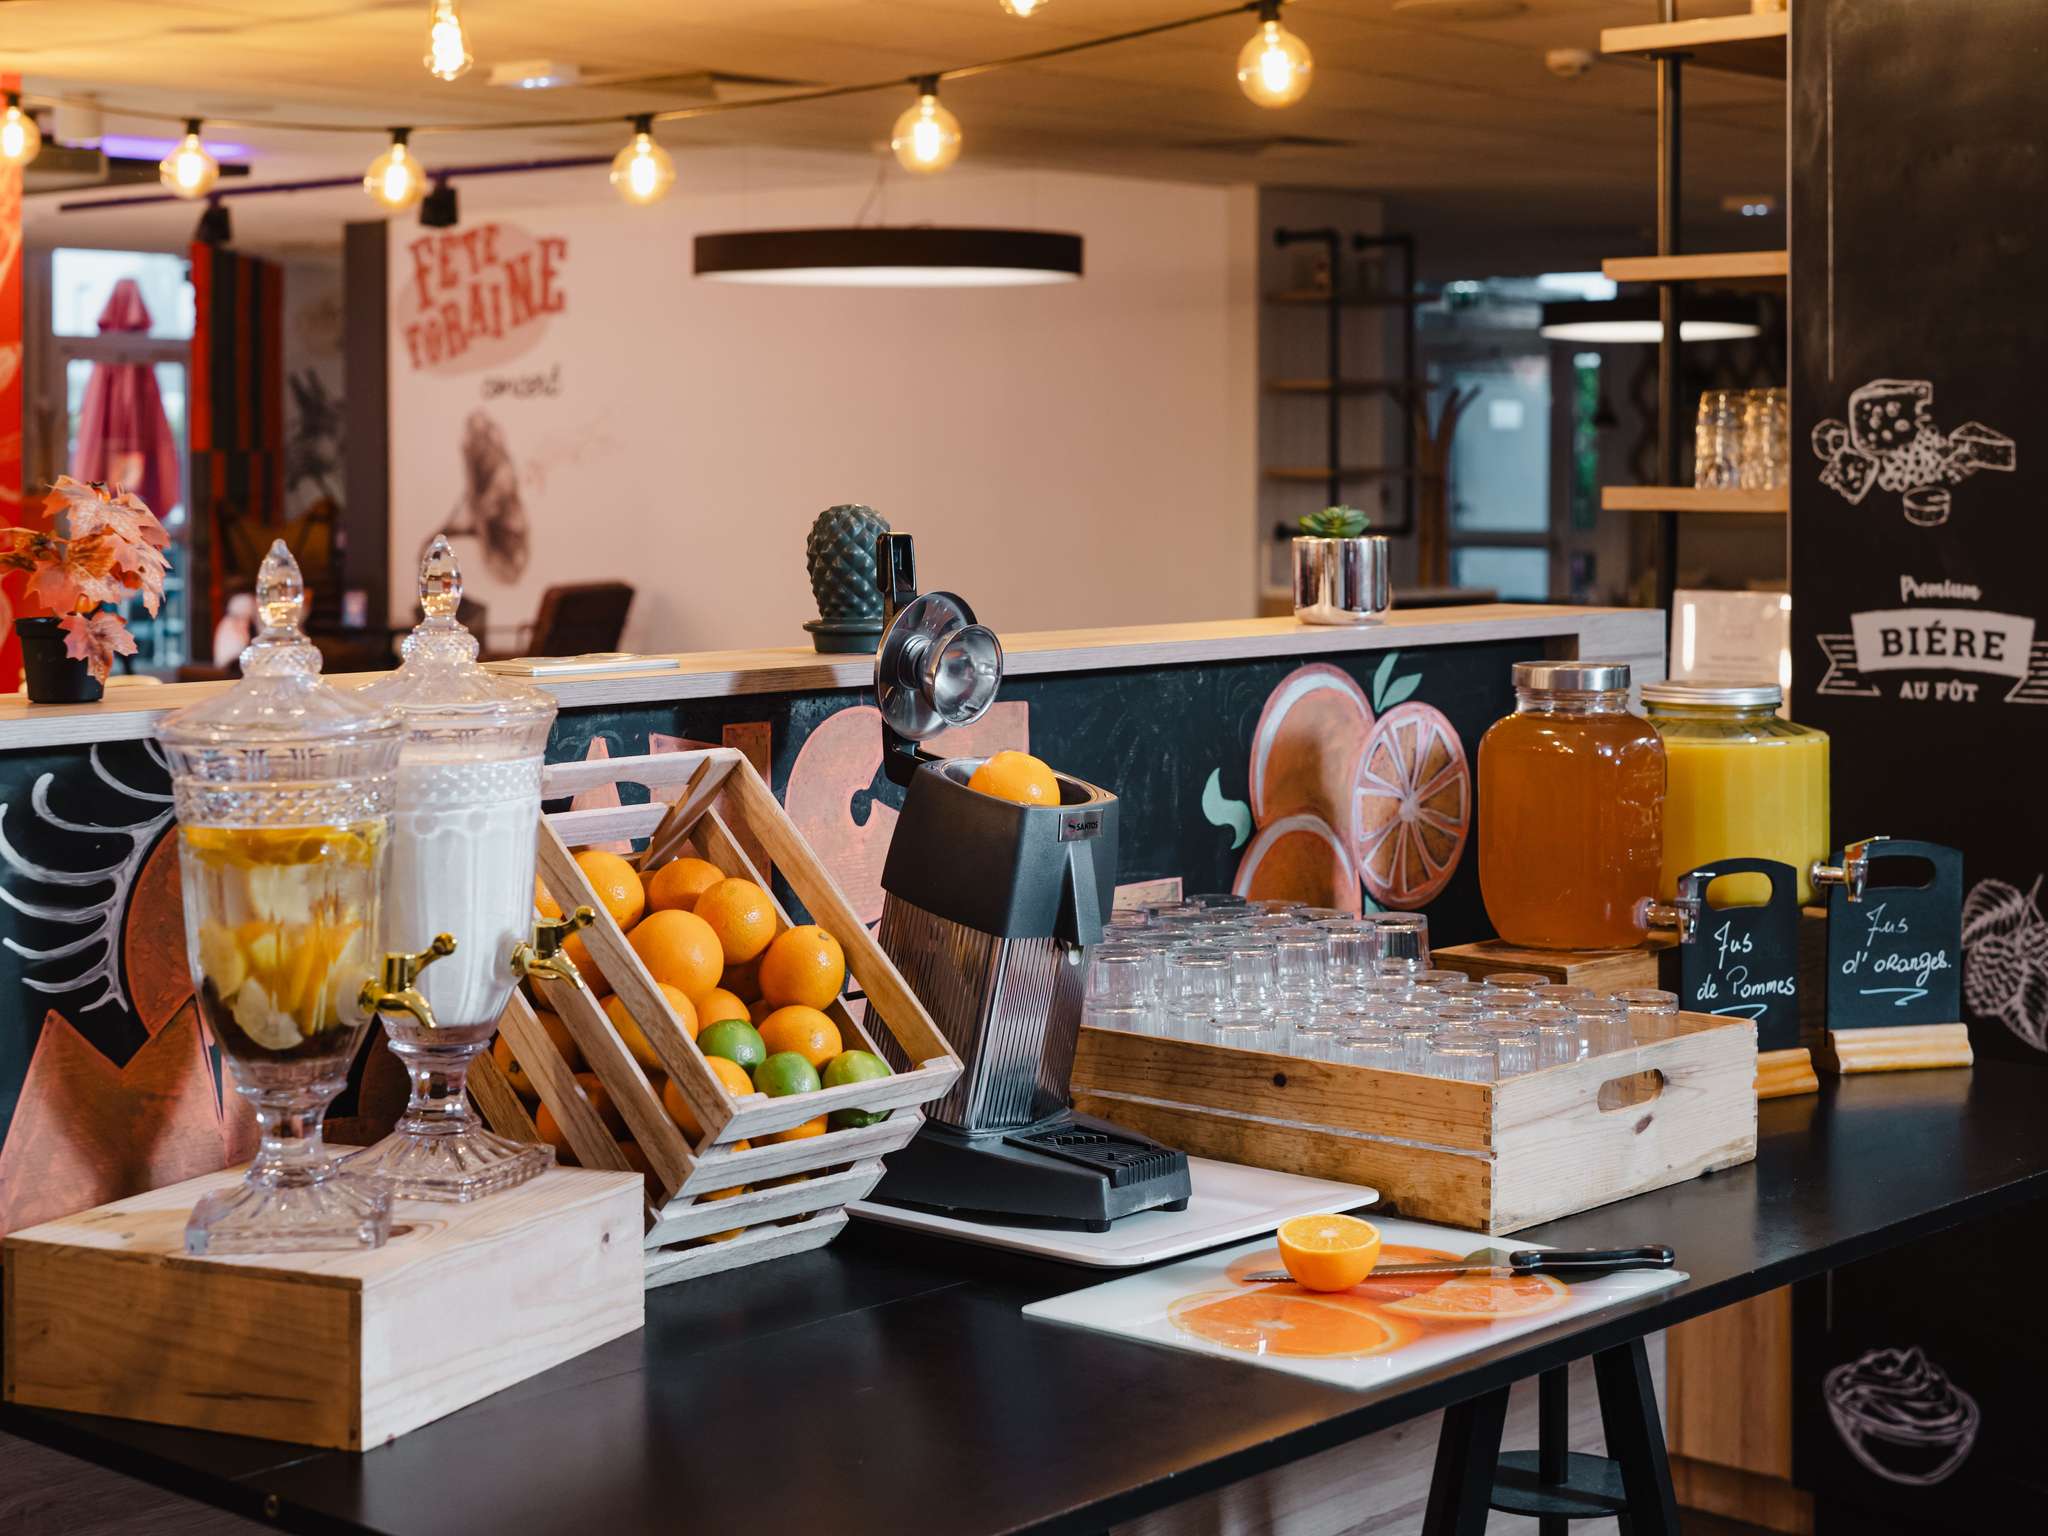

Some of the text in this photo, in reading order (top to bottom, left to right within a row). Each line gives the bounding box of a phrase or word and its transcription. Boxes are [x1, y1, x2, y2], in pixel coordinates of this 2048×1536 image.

[404, 233, 569, 371] FORAINE
[1899, 573, 1982, 603] Premium
[1879, 618, 2006, 662] BIÉRE
[1899, 678, 1979, 703] AU FÛT
[1075, 820, 1099, 832] SANTOS
[1865, 902, 1909, 948] Jus
[1713, 920, 1753, 971] Jus
[1696, 964, 1796, 1001] de Pommes
